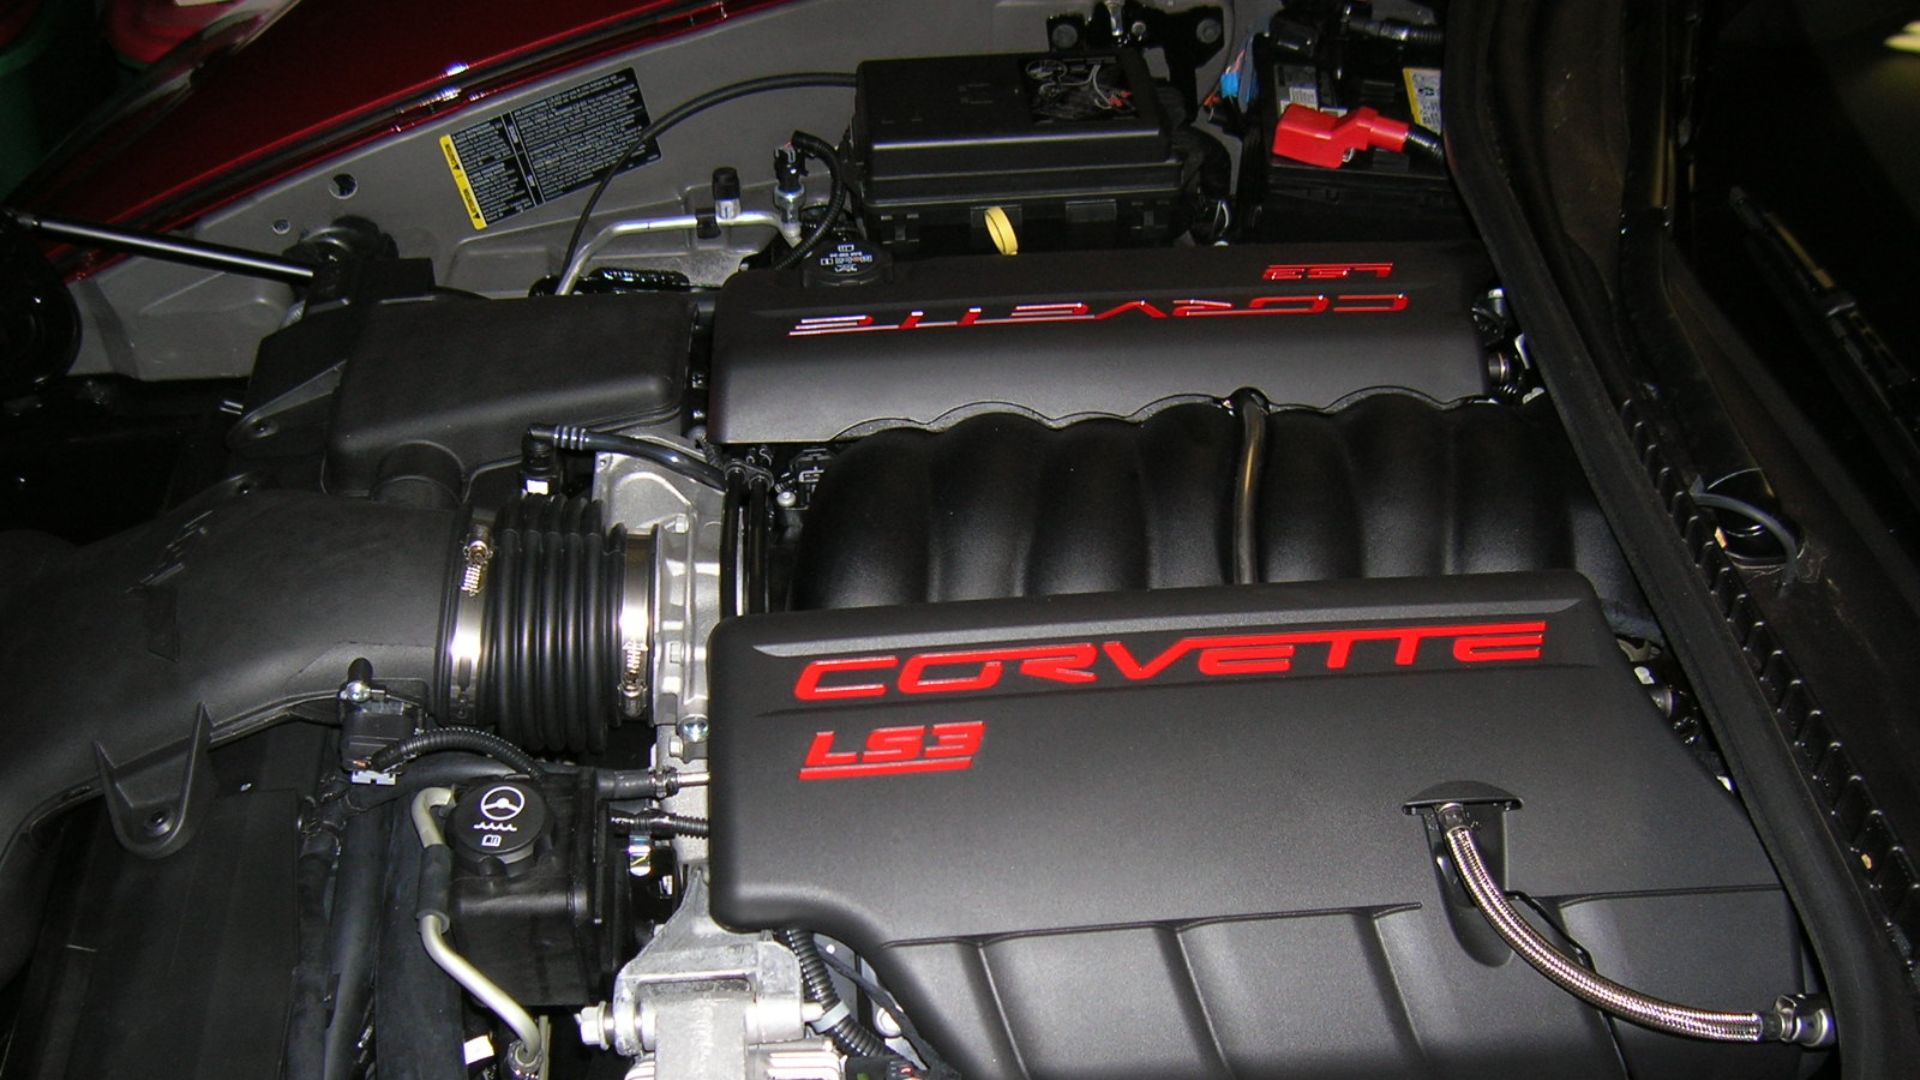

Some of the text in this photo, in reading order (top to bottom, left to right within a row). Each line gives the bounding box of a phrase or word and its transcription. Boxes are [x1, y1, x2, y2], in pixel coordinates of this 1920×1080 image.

[1263, 264, 1392, 280] LS3
[788, 294, 1409, 336] CORVETTE
[793, 620, 1548, 701] CORVETTE
[799, 720, 986, 772] LS3
